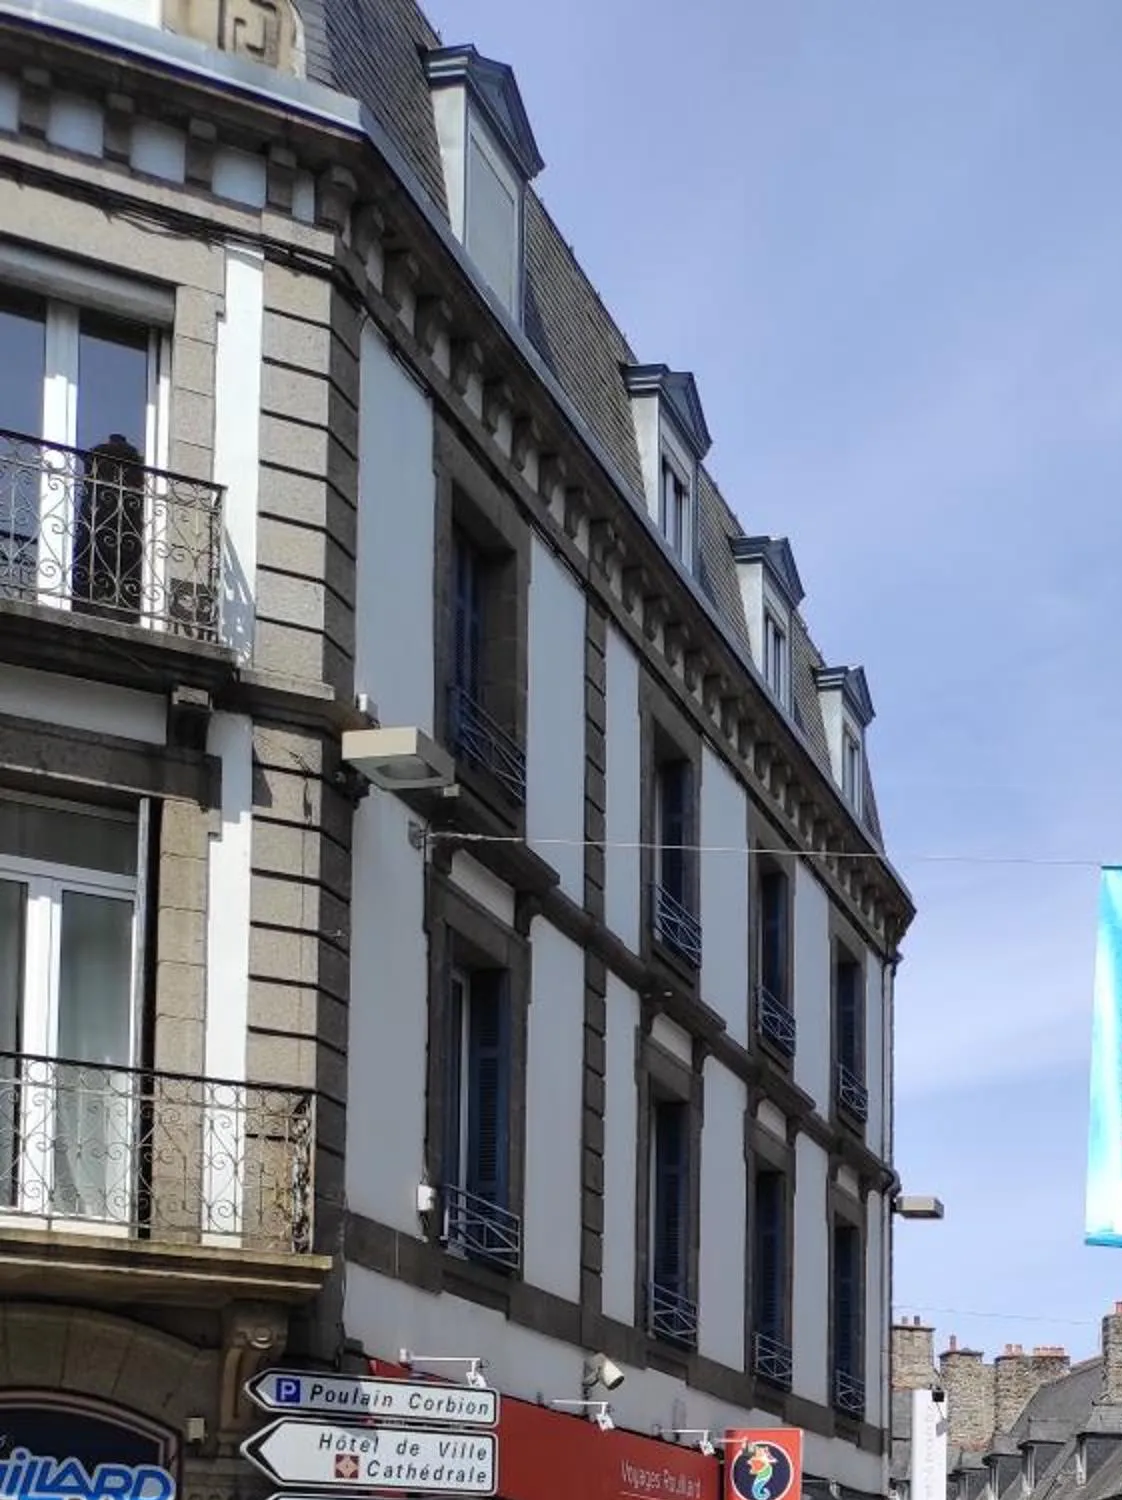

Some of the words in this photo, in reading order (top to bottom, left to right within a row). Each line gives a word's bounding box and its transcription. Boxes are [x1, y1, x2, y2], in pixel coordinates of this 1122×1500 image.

[280, 1381, 297, 1400] P
[310, 1384, 393, 1408] Poulain
[408, 1392, 489, 1416] Corbion
[319, 1432, 379, 1453] Hôtel
[396, 1439, 420, 1455] de
[439, 1441, 487, 1461] Ville
[367, 1460, 487, 1483] Cathédrale
[620, 1459, 661, 1490] Voyages
